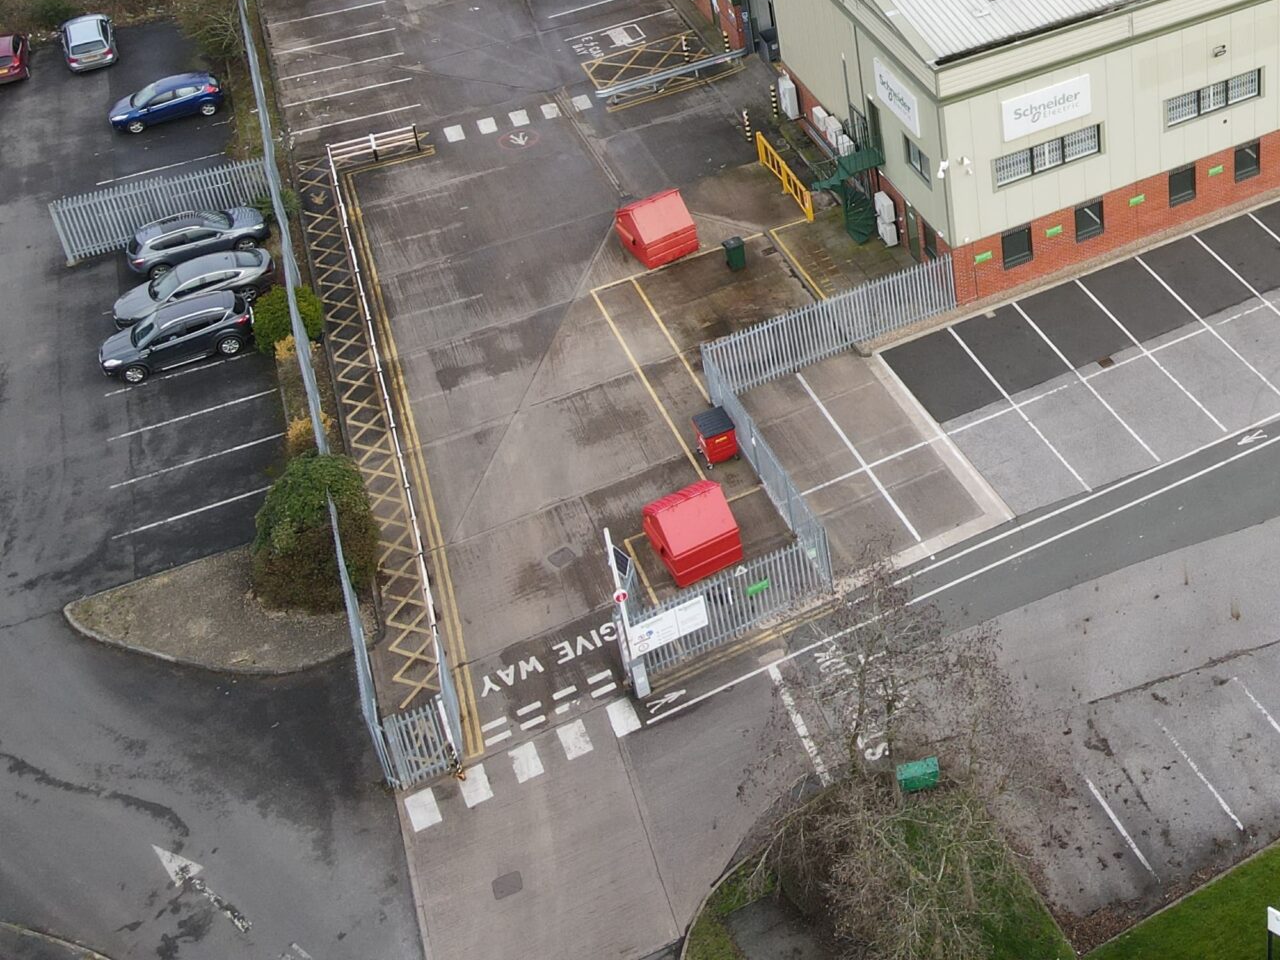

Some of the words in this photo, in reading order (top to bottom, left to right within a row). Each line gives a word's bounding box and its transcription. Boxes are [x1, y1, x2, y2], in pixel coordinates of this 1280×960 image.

[1013, 91, 1081, 121] Schneider
[1042, 101, 1081, 119] Electric
[551, 621, 619, 665] GIVE
[481, 655, 545, 698] WAY
